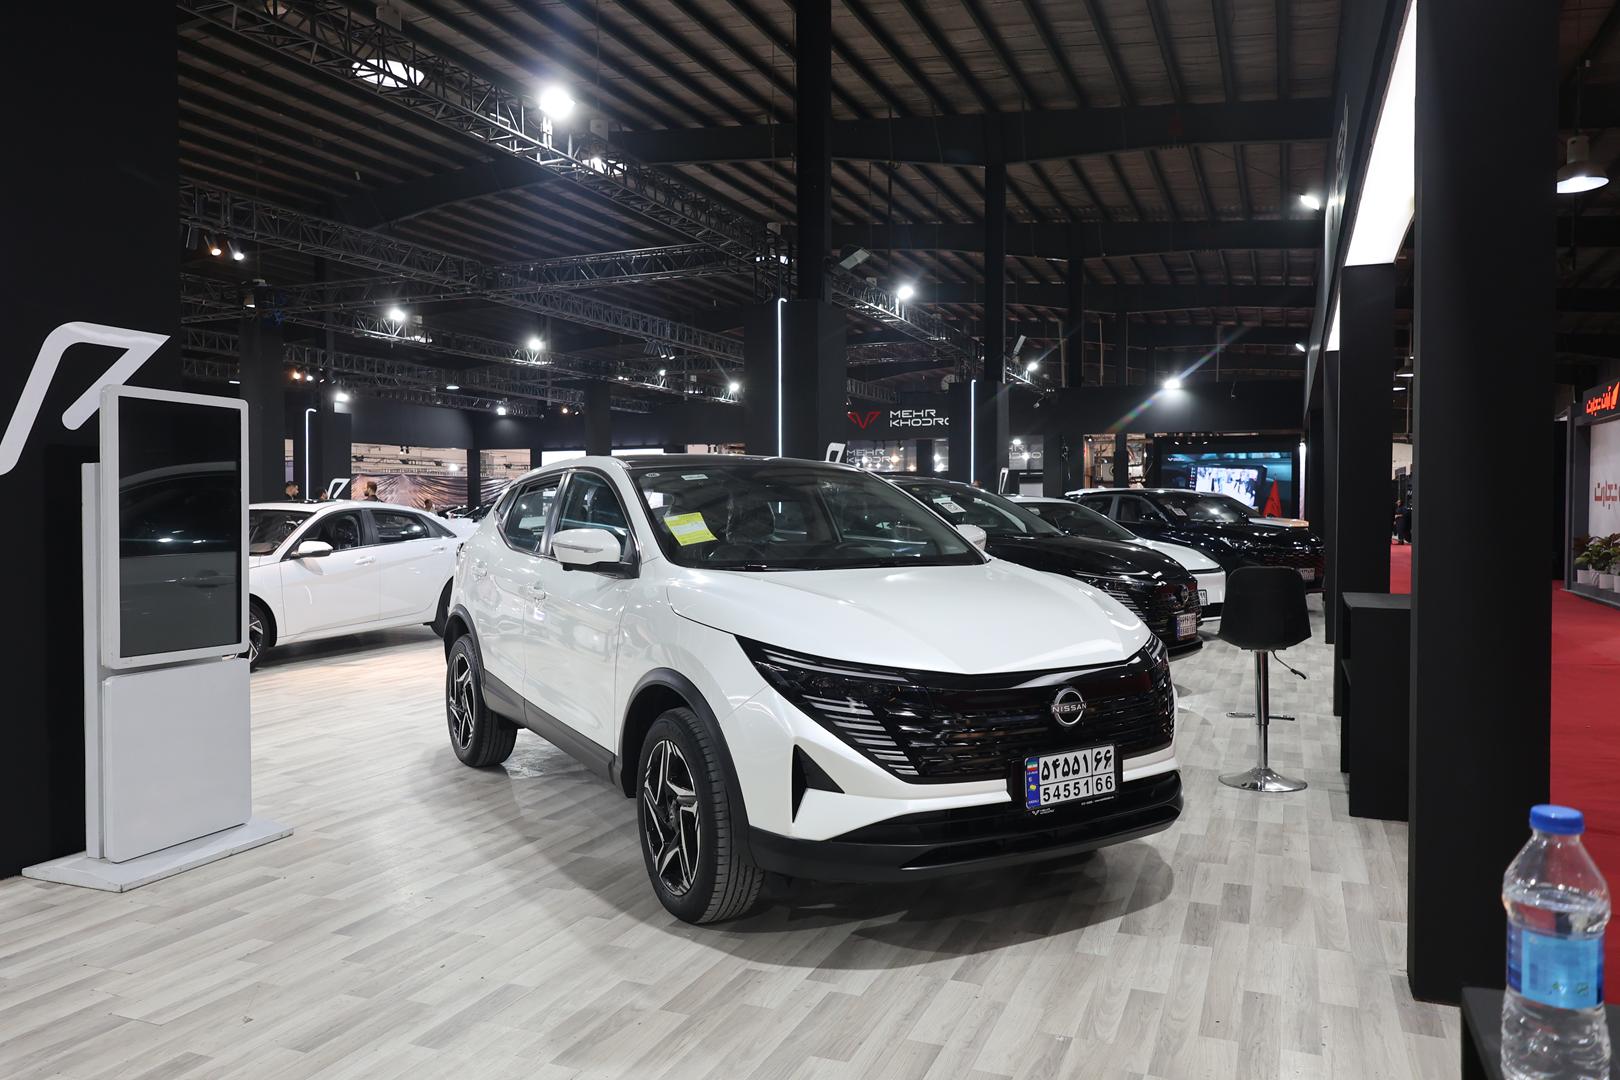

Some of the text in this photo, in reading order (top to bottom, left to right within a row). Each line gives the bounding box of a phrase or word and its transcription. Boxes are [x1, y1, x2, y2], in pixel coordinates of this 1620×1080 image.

[889, 409, 936, 418] MEHR
[1052, 702, 1087, 712] NISSAN
[1043, 779, 1090, 802] 54551
[1095, 775, 1113, 792] 66
